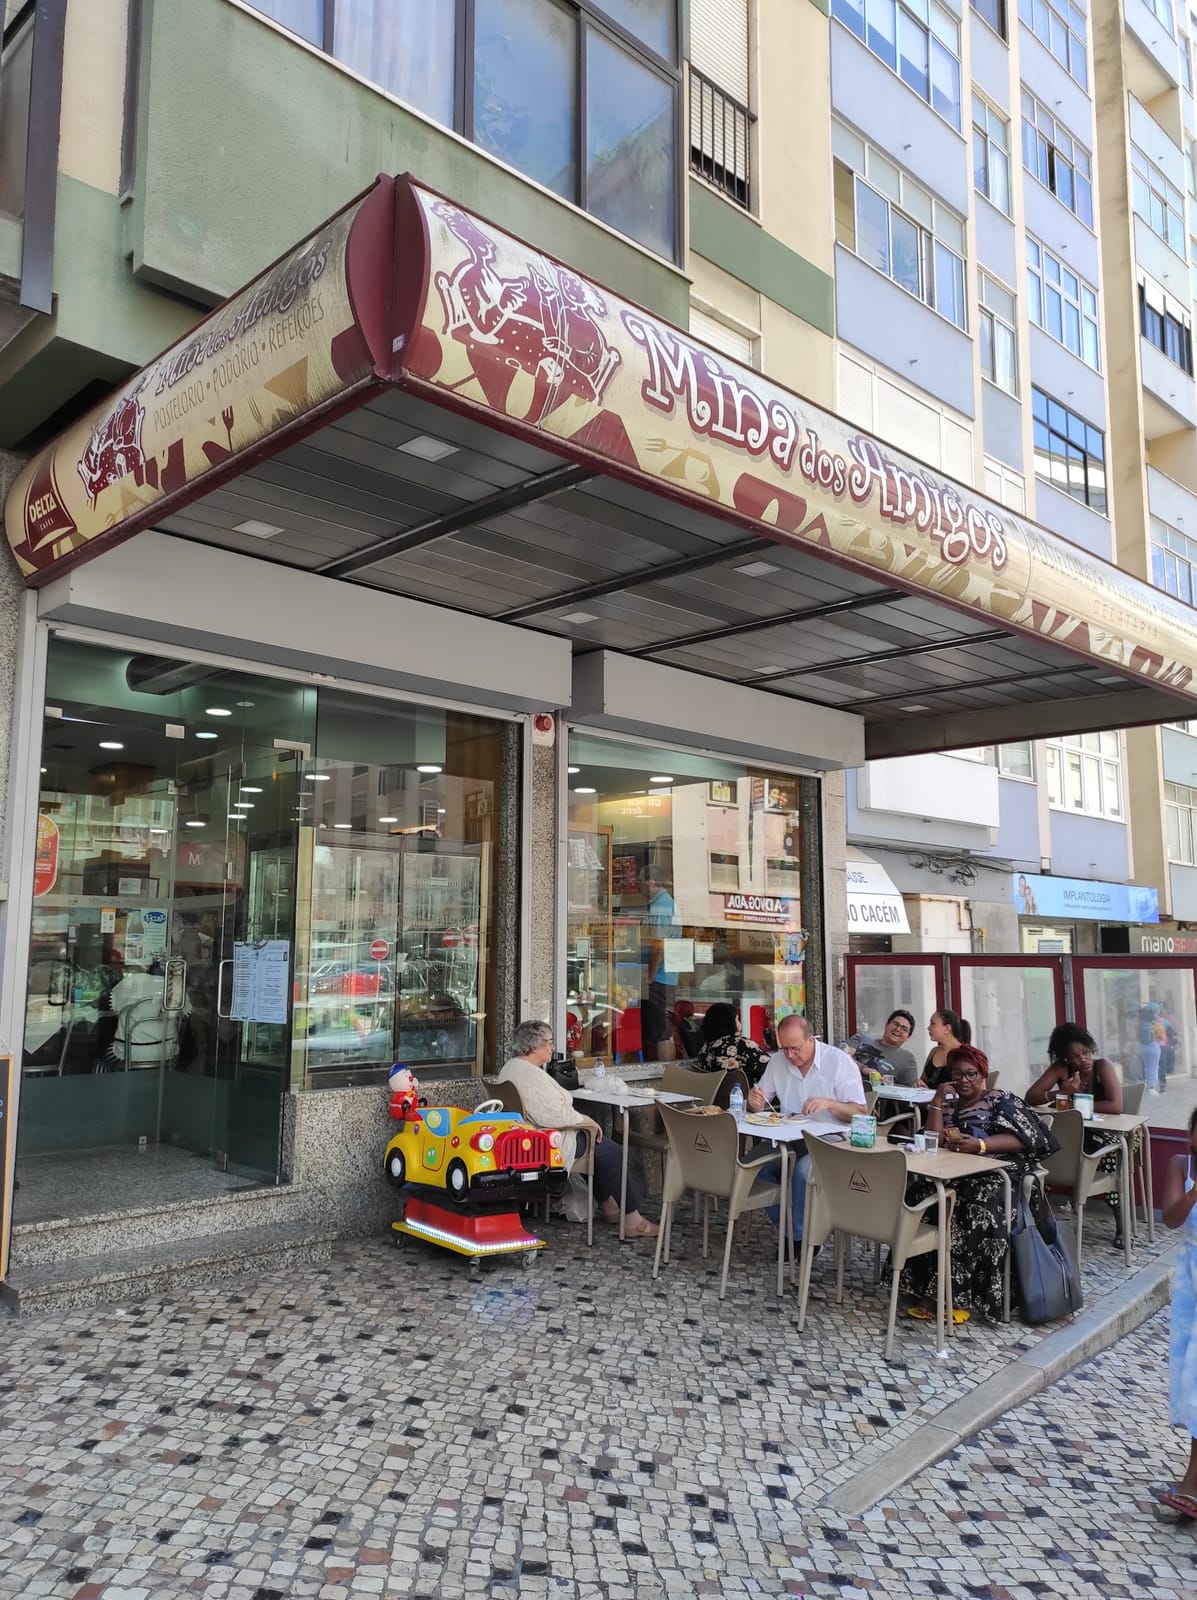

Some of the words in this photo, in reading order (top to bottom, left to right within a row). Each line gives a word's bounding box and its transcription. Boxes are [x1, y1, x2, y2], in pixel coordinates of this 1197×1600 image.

[622, 310, 797, 470] Mina
[800, 428, 847, 496] dos
[848, 434, 1009, 570] Amigos
[29, 492, 57, 523] DELTA
[860, 901, 900, 923] CACÉM
